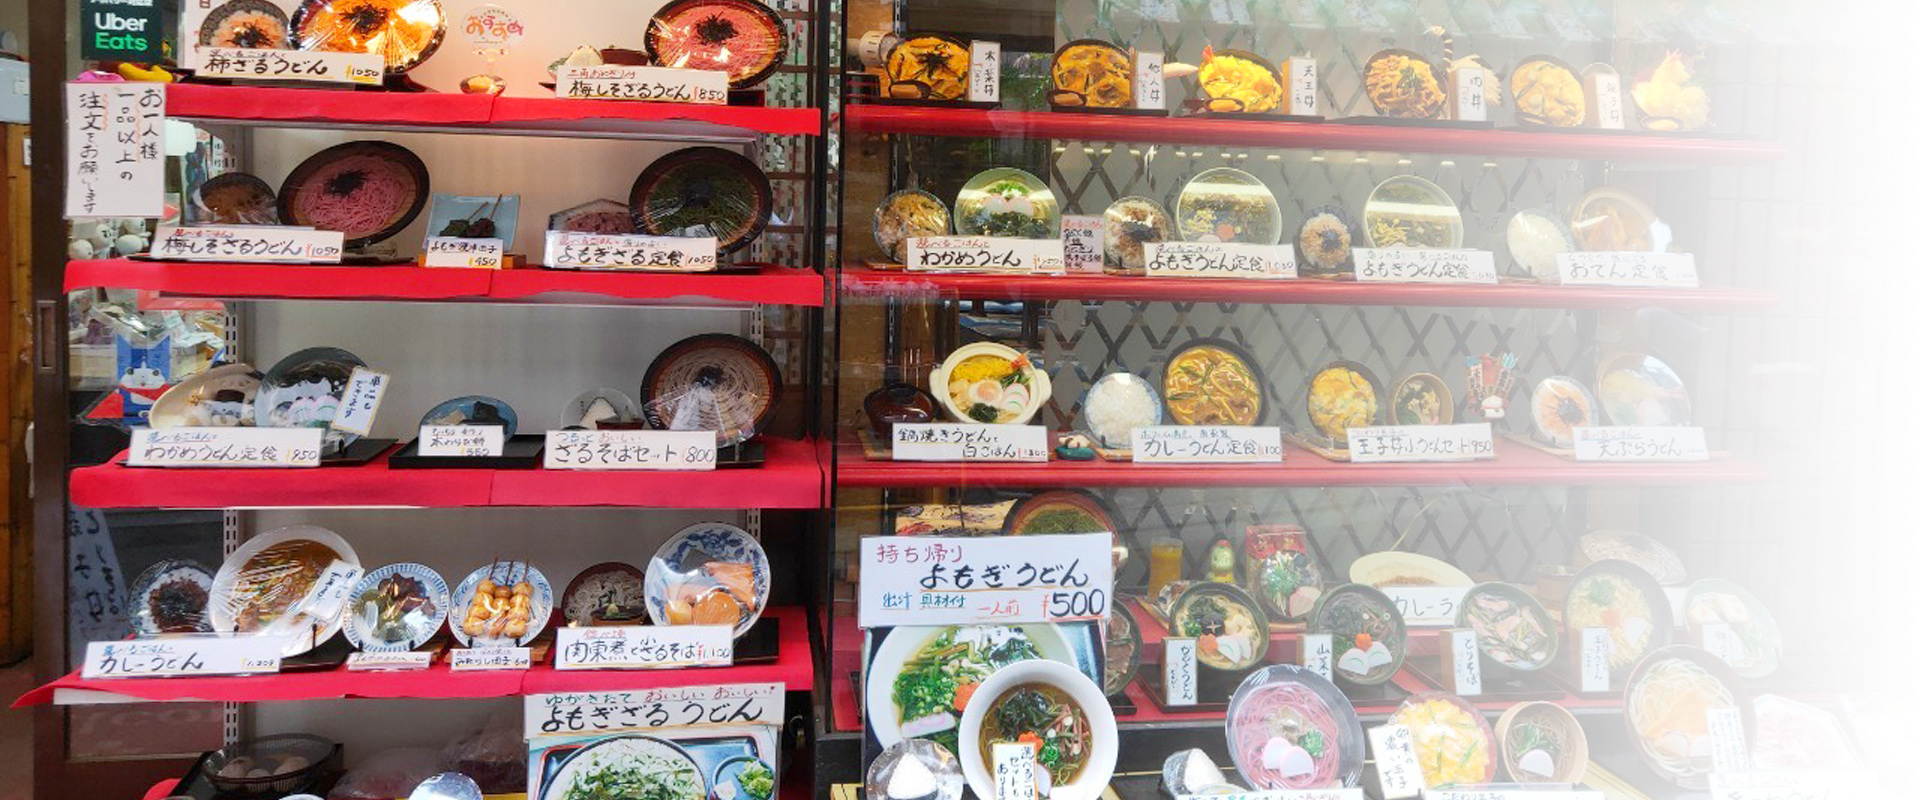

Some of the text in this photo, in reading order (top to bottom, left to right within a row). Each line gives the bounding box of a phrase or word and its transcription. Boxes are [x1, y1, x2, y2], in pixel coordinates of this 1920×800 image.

[95, 12, 148, 31] Uber
[466, 15, 524, 40] おすすめ
[95, 32, 148, 51] Eats
[569, 80, 690, 100] 梅しそざるうどん
[139, 88, 163, 160] お一人様
[115, 92, 137, 181] 一品以上の
[162, 237, 302, 255] 梅しそざるうどん
[558, 245, 684, 268] よもぎざる定食
[920, 250, 1022, 267] わかめうどん
[1149, 252, 1265, 272] よもぎうどん定食
[1363, 259, 1470, 279] よもぎうどん定食
[1569, 262, 1669, 281] おでん定食
[144, 443, 278, 461] わかめうどん定食
[555, 443, 677, 464] ざるそばセット
[962, 443, 1016, 458] 白ごはん
[1144, 439, 1257, 458] カレーうどん定食
[1598, 437, 1682, 458] 天ぷらうどん
[876, 543, 963, 564] 持ち帰り
[920, 558, 1089, 590] よもぎうどん
[882, 588, 1106, 618] 出汁 具材付 一人前 ¥500
[1395, 596, 1457, 617] カレーラ
[99, 652, 205, 674] カレーうどん
[1181, 645, 1193, 700] かやくうどん
[545, 693, 632, 706] ゆがきたて
[645, 691, 704, 703] おいしい
[541, 698, 763, 732] よもぎざるうどん
